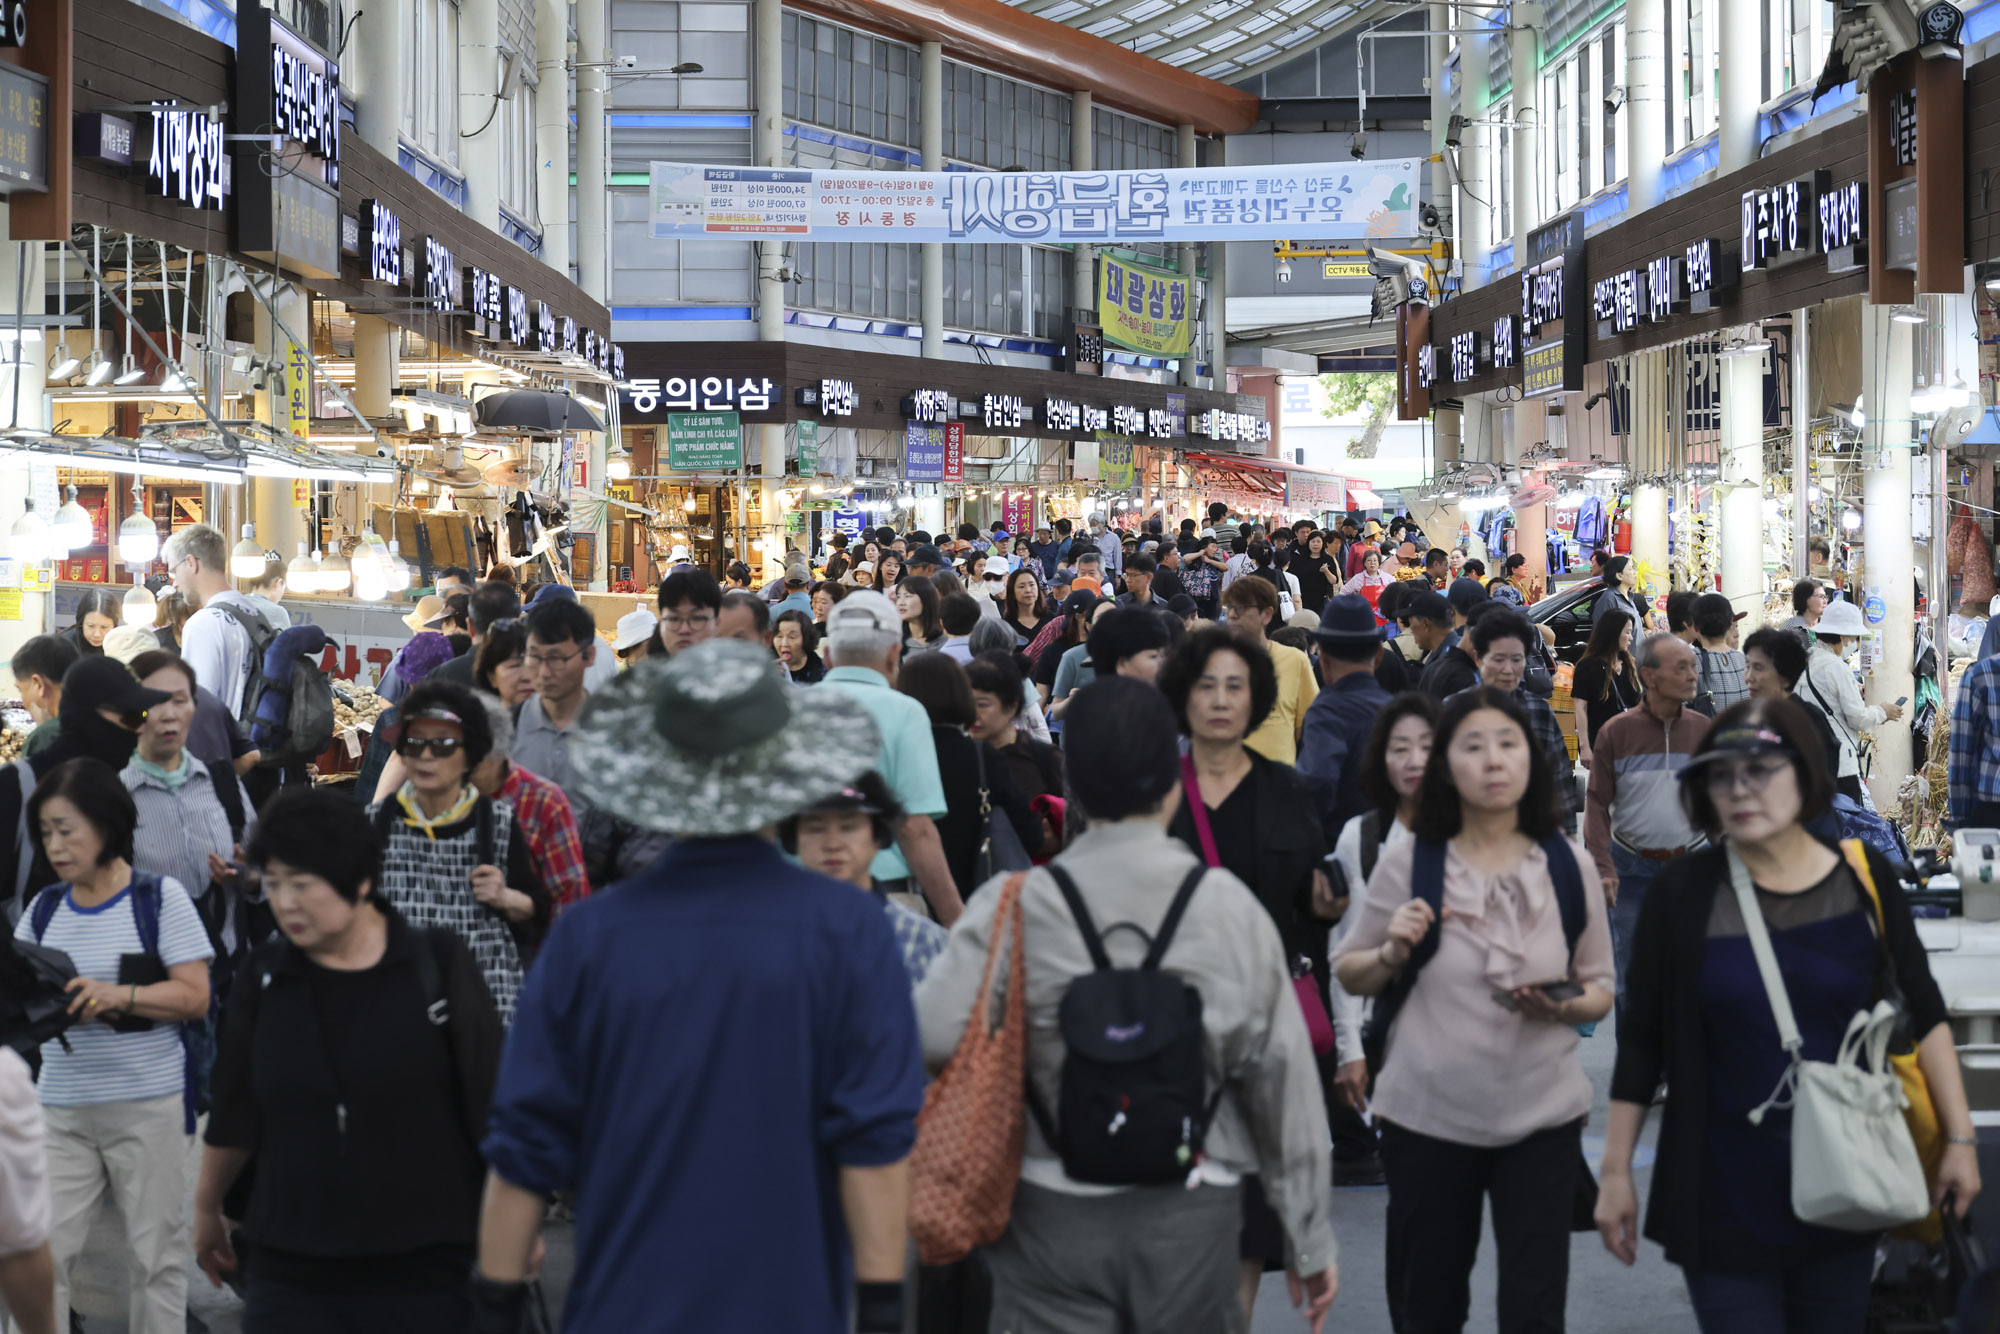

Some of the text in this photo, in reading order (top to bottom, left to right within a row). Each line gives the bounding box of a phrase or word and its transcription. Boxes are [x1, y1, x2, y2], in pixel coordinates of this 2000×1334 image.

[150, 99, 223, 211] 지혜상회
[1743, 202, 1752, 262] P
[1758, 181, 1799, 259] 주차장
[1819, 180, 1860, 254] 형제상회
[1328, 267, 1348, 275] CCTV
[1106, 260, 1186, 321] 대광상회
[629, 376, 773, 413] 동의인삼
[821, 378, 853, 416] 동의인삼
[914, 388, 934, 421] 상형당
[984, 393, 1021, 428] 충남인삼
[1046, 397, 1072, 430] 한수인삼
[1148, 407, 1171, 439] 현대인삼
[684, 430, 696, 439] LINH
[697, 430, 706, 438] CHI
